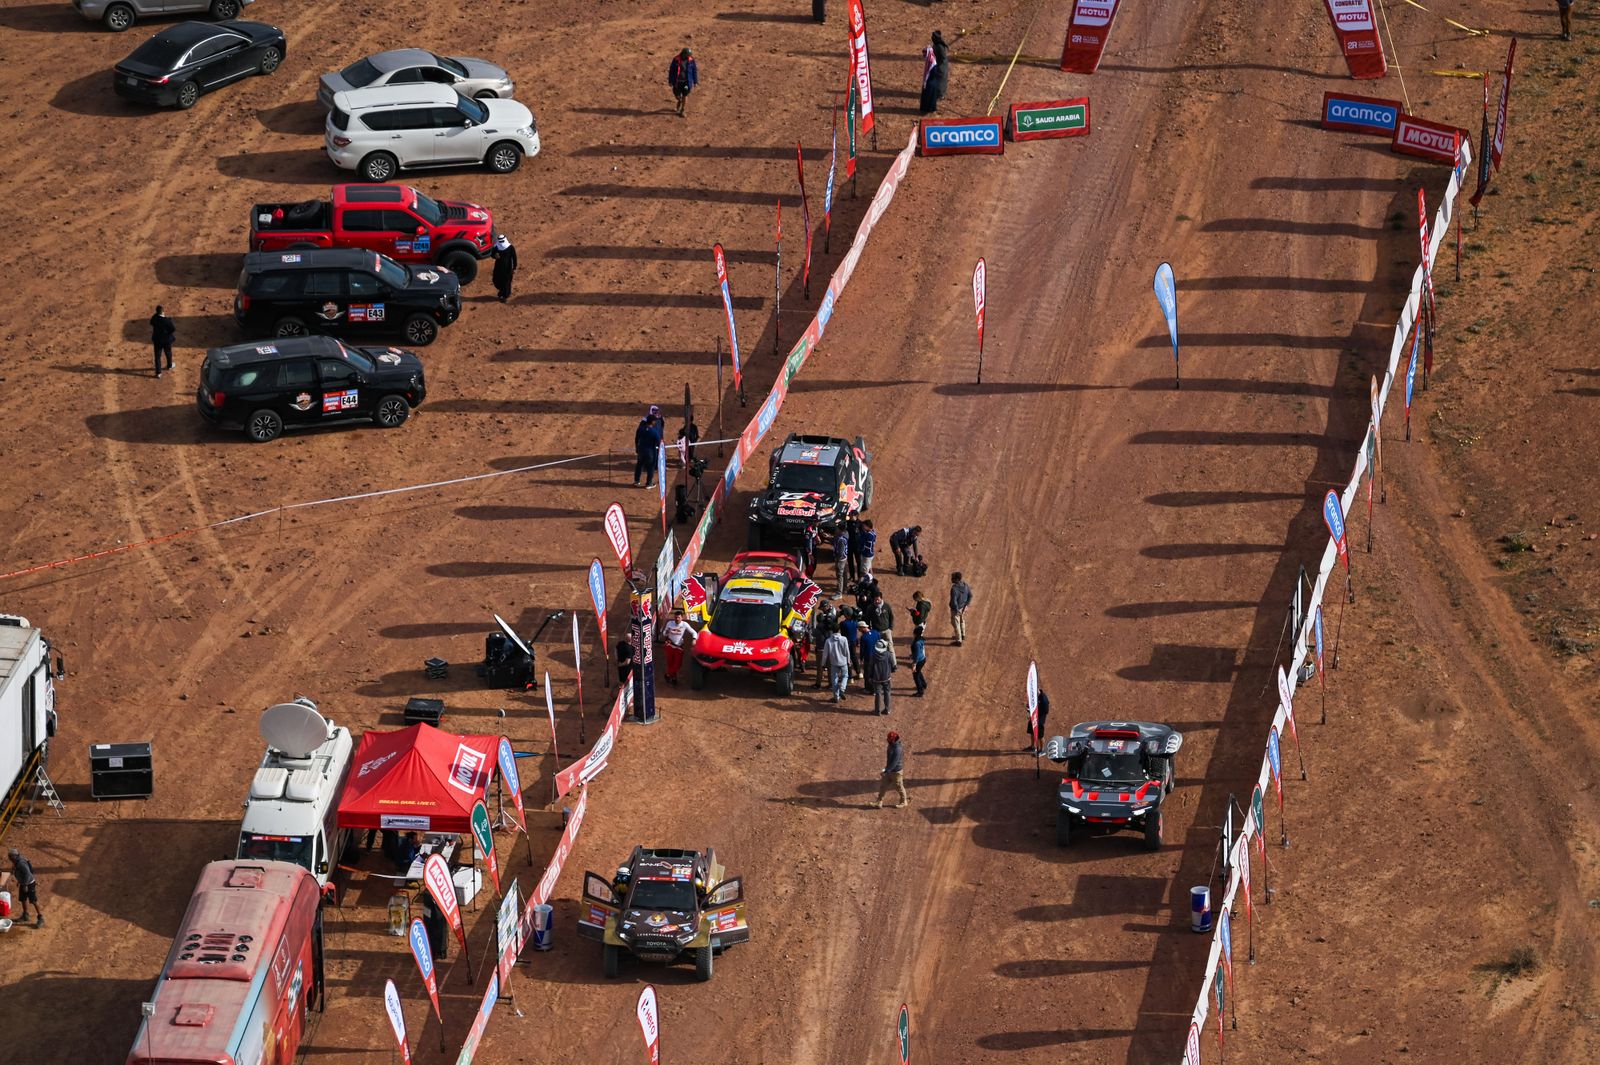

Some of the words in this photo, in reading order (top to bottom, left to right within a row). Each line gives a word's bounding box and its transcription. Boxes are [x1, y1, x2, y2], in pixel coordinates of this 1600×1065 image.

[1080, 8, 1107, 16] MOTUL
[1035, 116, 1055, 124] SAUDI
[1056, 113, 1080, 122] ARABIA
[1331, 105, 1392, 123] aramco
[930, 129, 995, 143] aramco
[1406, 129, 1455, 152] MOTUL
[368, 309, 383, 318] E43
[342, 396, 356, 405] E44
[1327, 497, 1341, 537] aramco
[609, 512, 627, 554] MOTUL
[592, 564, 605, 611] aramco
[722, 644, 754, 655] BRX
[456, 751, 477, 787] MOTUL
[500, 744, 518, 789] aramco
[429, 863, 455, 908] MOTUL
[412, 923, 431, 973] aramco
[644, 1009, 657, 1036] Hero
